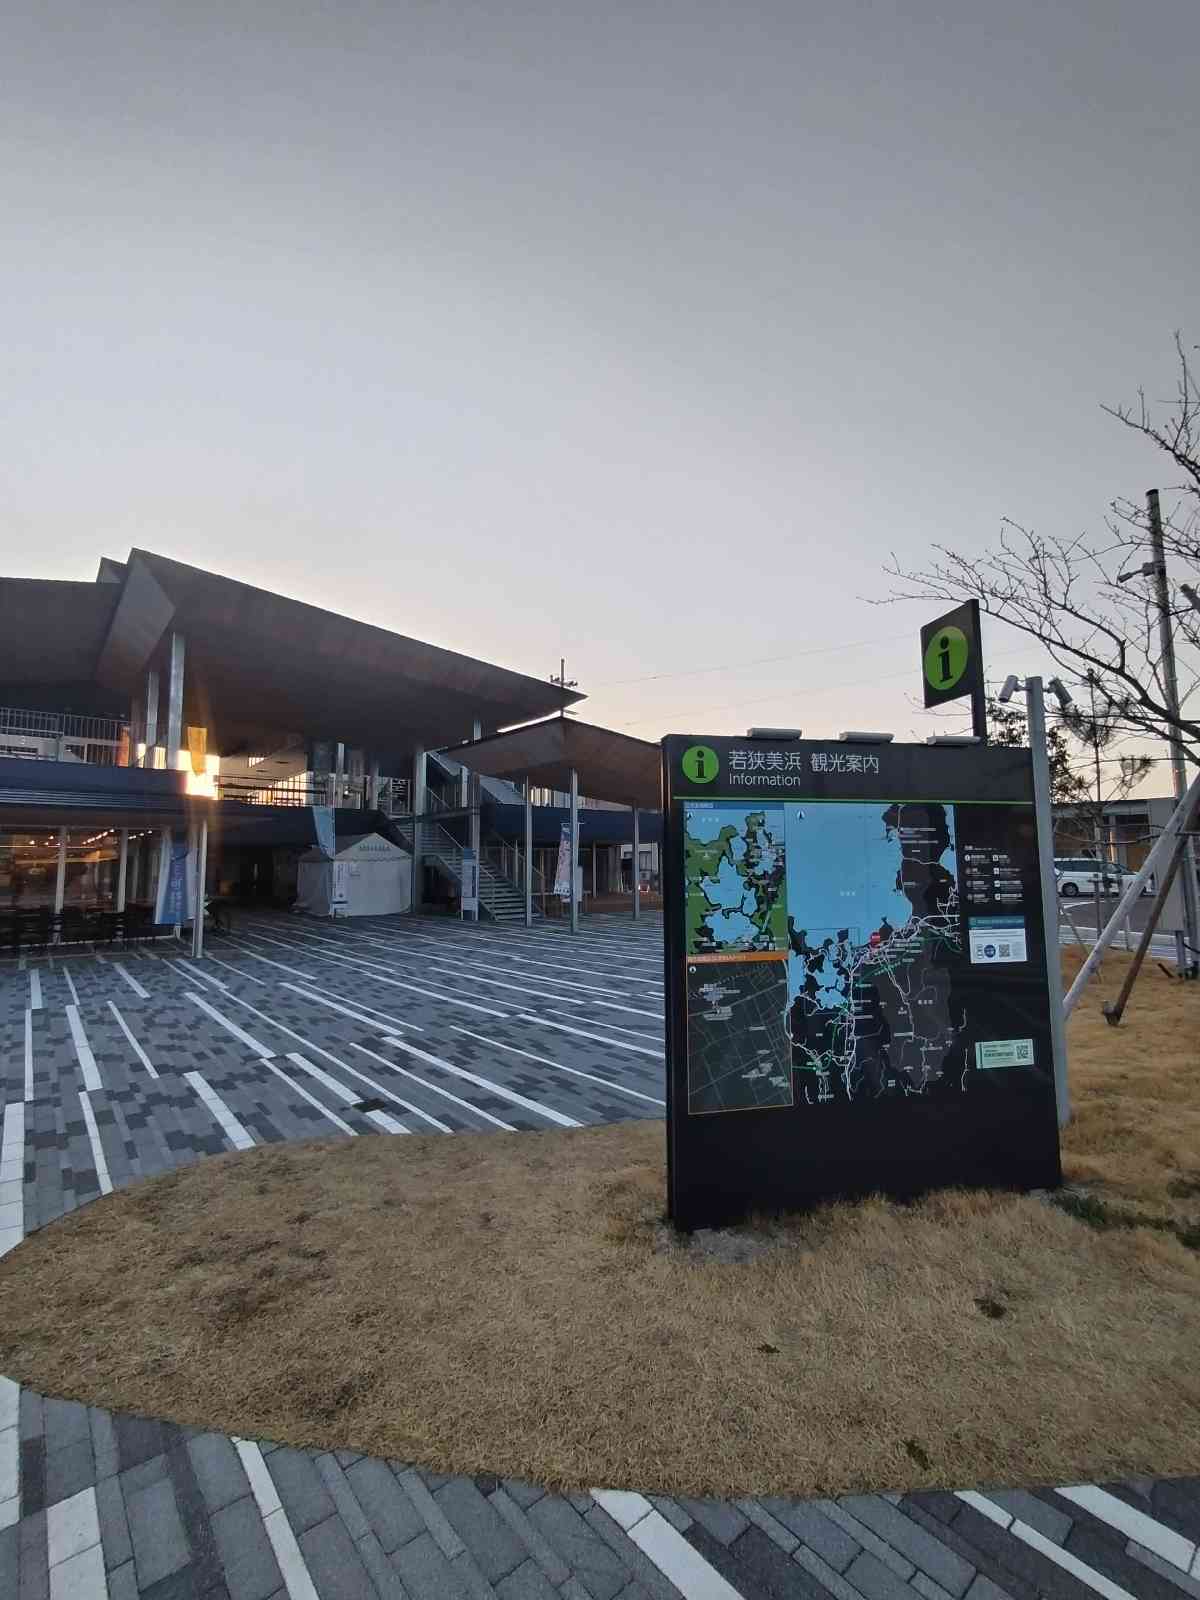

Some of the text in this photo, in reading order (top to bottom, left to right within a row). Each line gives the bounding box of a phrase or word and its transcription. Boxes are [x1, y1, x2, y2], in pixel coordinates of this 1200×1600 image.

[938, 636, 953, 682] i
[692, 750, 706, 778] i
[728, 750, 879, 774] 若狭美浜 観光案内
[729, 773, 801, 786] Information
